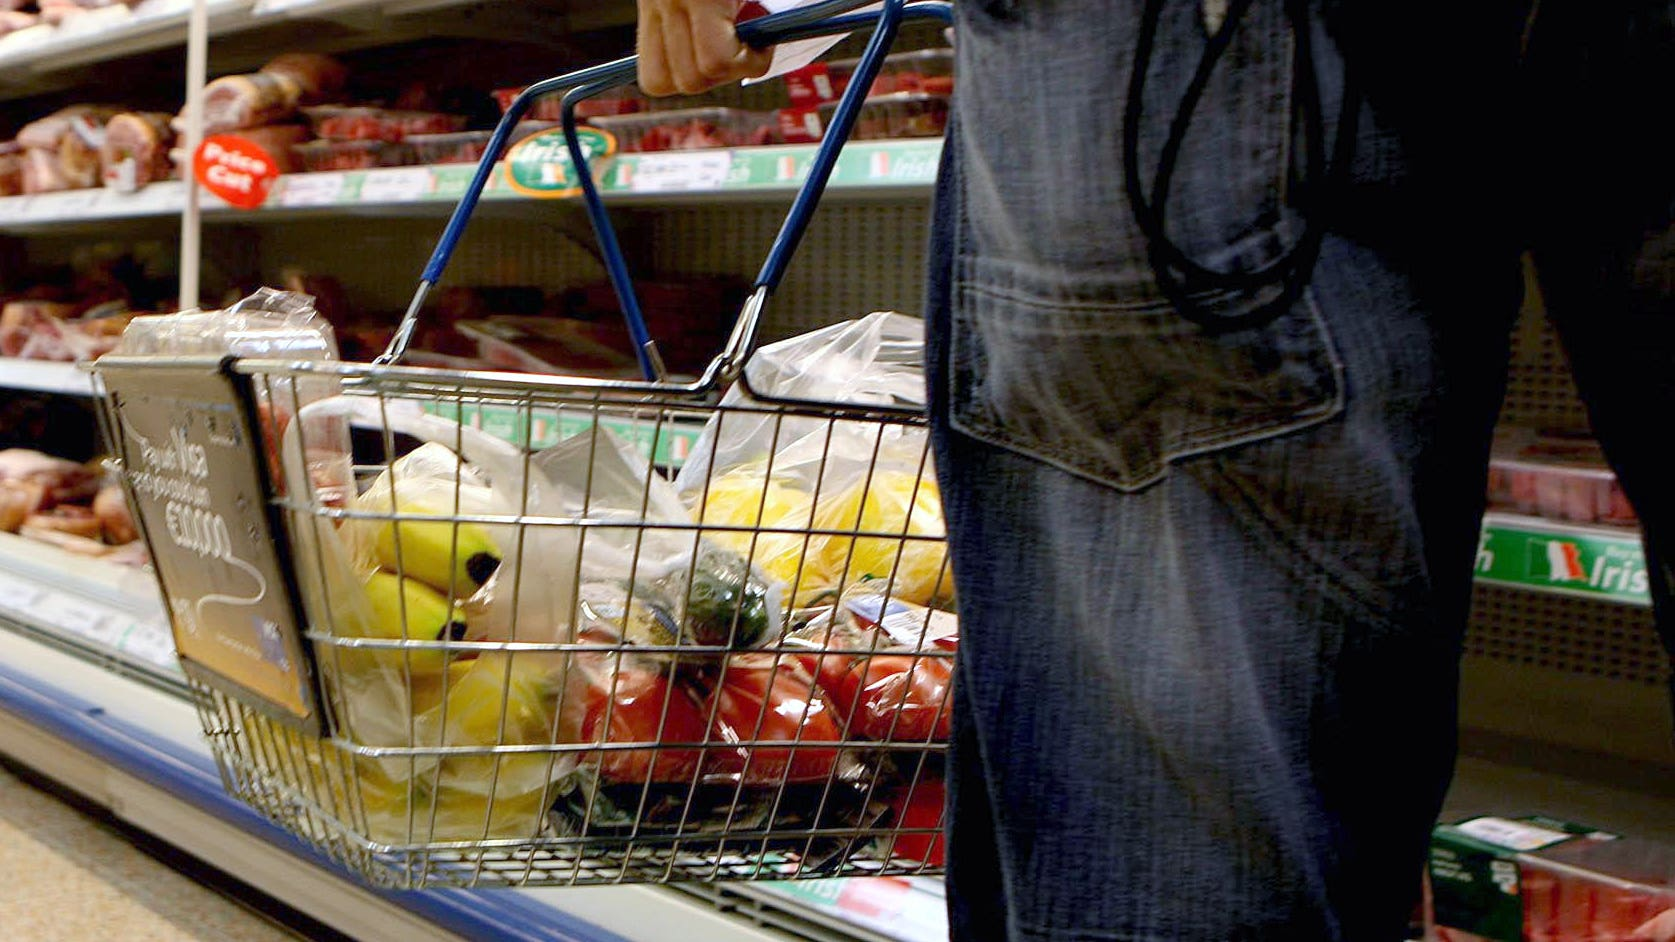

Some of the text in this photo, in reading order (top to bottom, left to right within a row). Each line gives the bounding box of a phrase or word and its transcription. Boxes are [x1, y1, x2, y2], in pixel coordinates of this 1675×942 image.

[202, 141, 267, 175] Price
[206, 164, 253, 194] Cut
[1589, 555, 1649, 593] Iris
